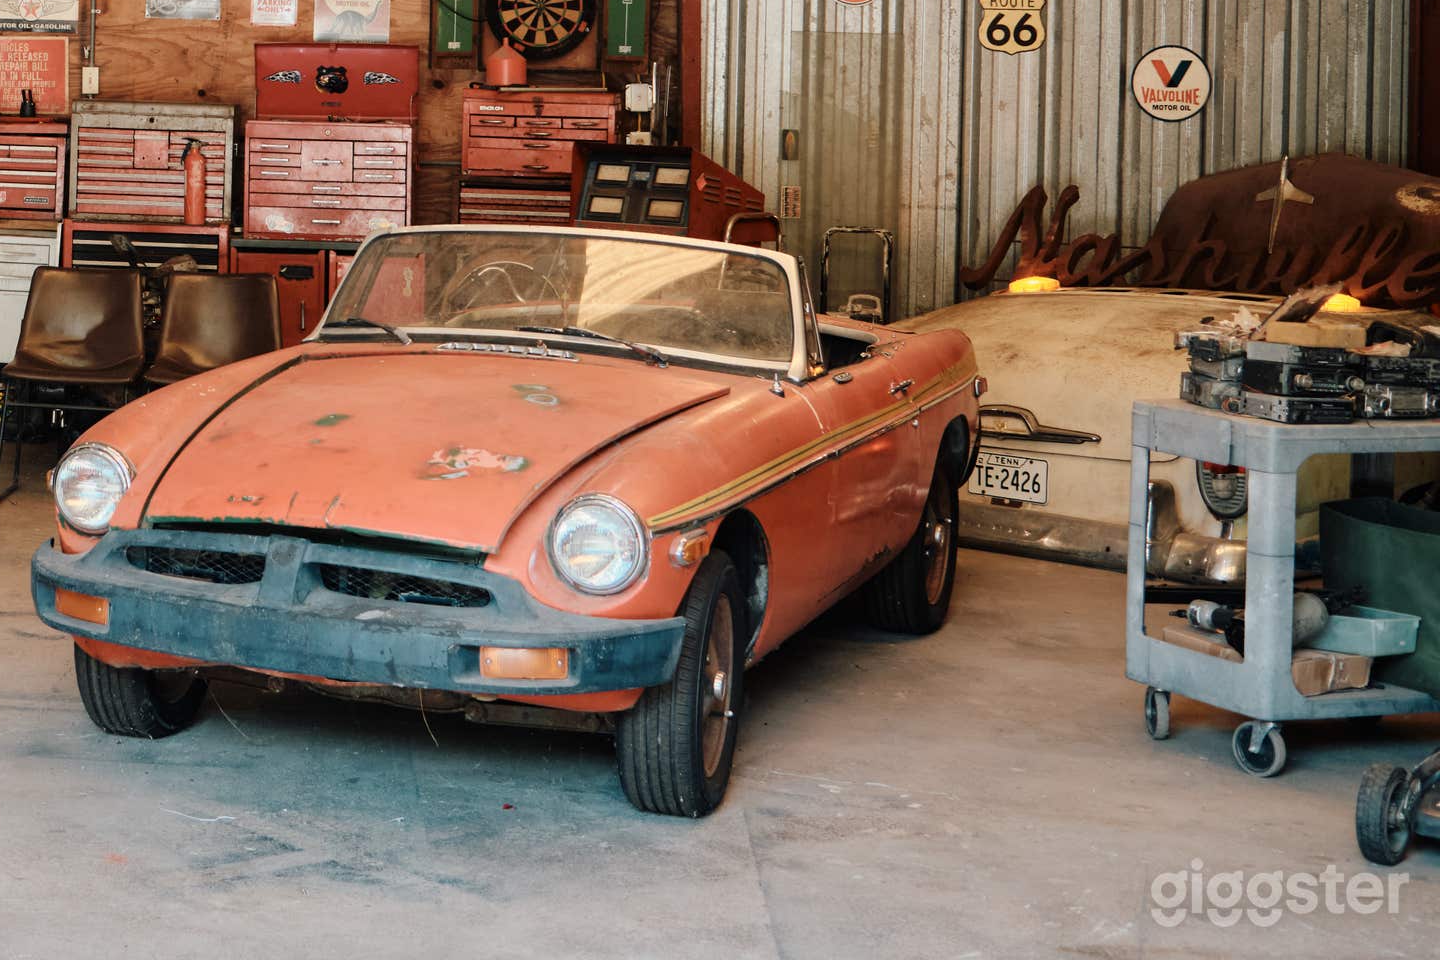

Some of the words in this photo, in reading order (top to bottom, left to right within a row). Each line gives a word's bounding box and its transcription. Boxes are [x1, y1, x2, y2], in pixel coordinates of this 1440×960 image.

[986, 13, 1038, 46] 66
[7, 52, 49, 62] RELEASED
[0, 61, 29, 71] REPAIR
[31, 62, 48, 72] BILL
[10, 71, 19, 80] IN
[1140, 87, 1200, 106] VALVOLINE
[1178, 104, 1192, 112] OIL
[995, 456, 1019, 466] TENN
